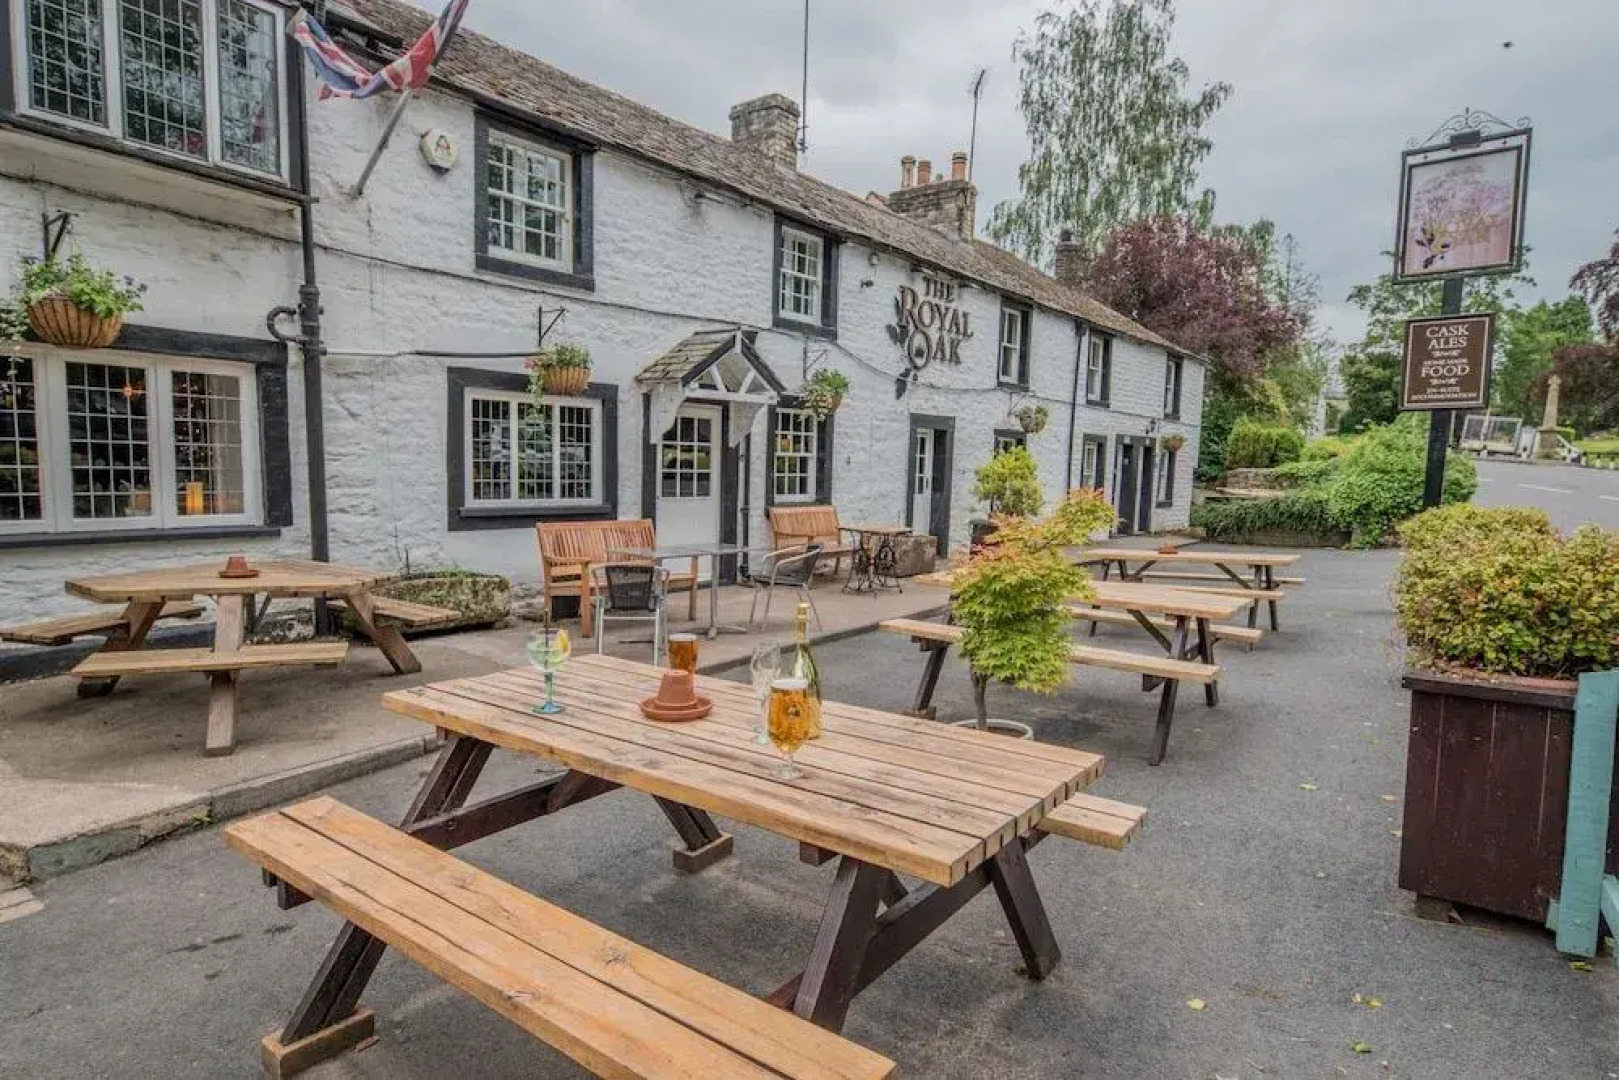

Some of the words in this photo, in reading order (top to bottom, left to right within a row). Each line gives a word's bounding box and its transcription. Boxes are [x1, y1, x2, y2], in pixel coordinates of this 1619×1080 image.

[922, 276, 955, 302] THE
[899, 285, 974, 337] ROYAL
[1426, 324, 1469, 338] CASK
[907, 329, 962, 370] OAK
[1427, 337, 1468, 350] ALES
[1421, 365, 1471, 378] FOOD
